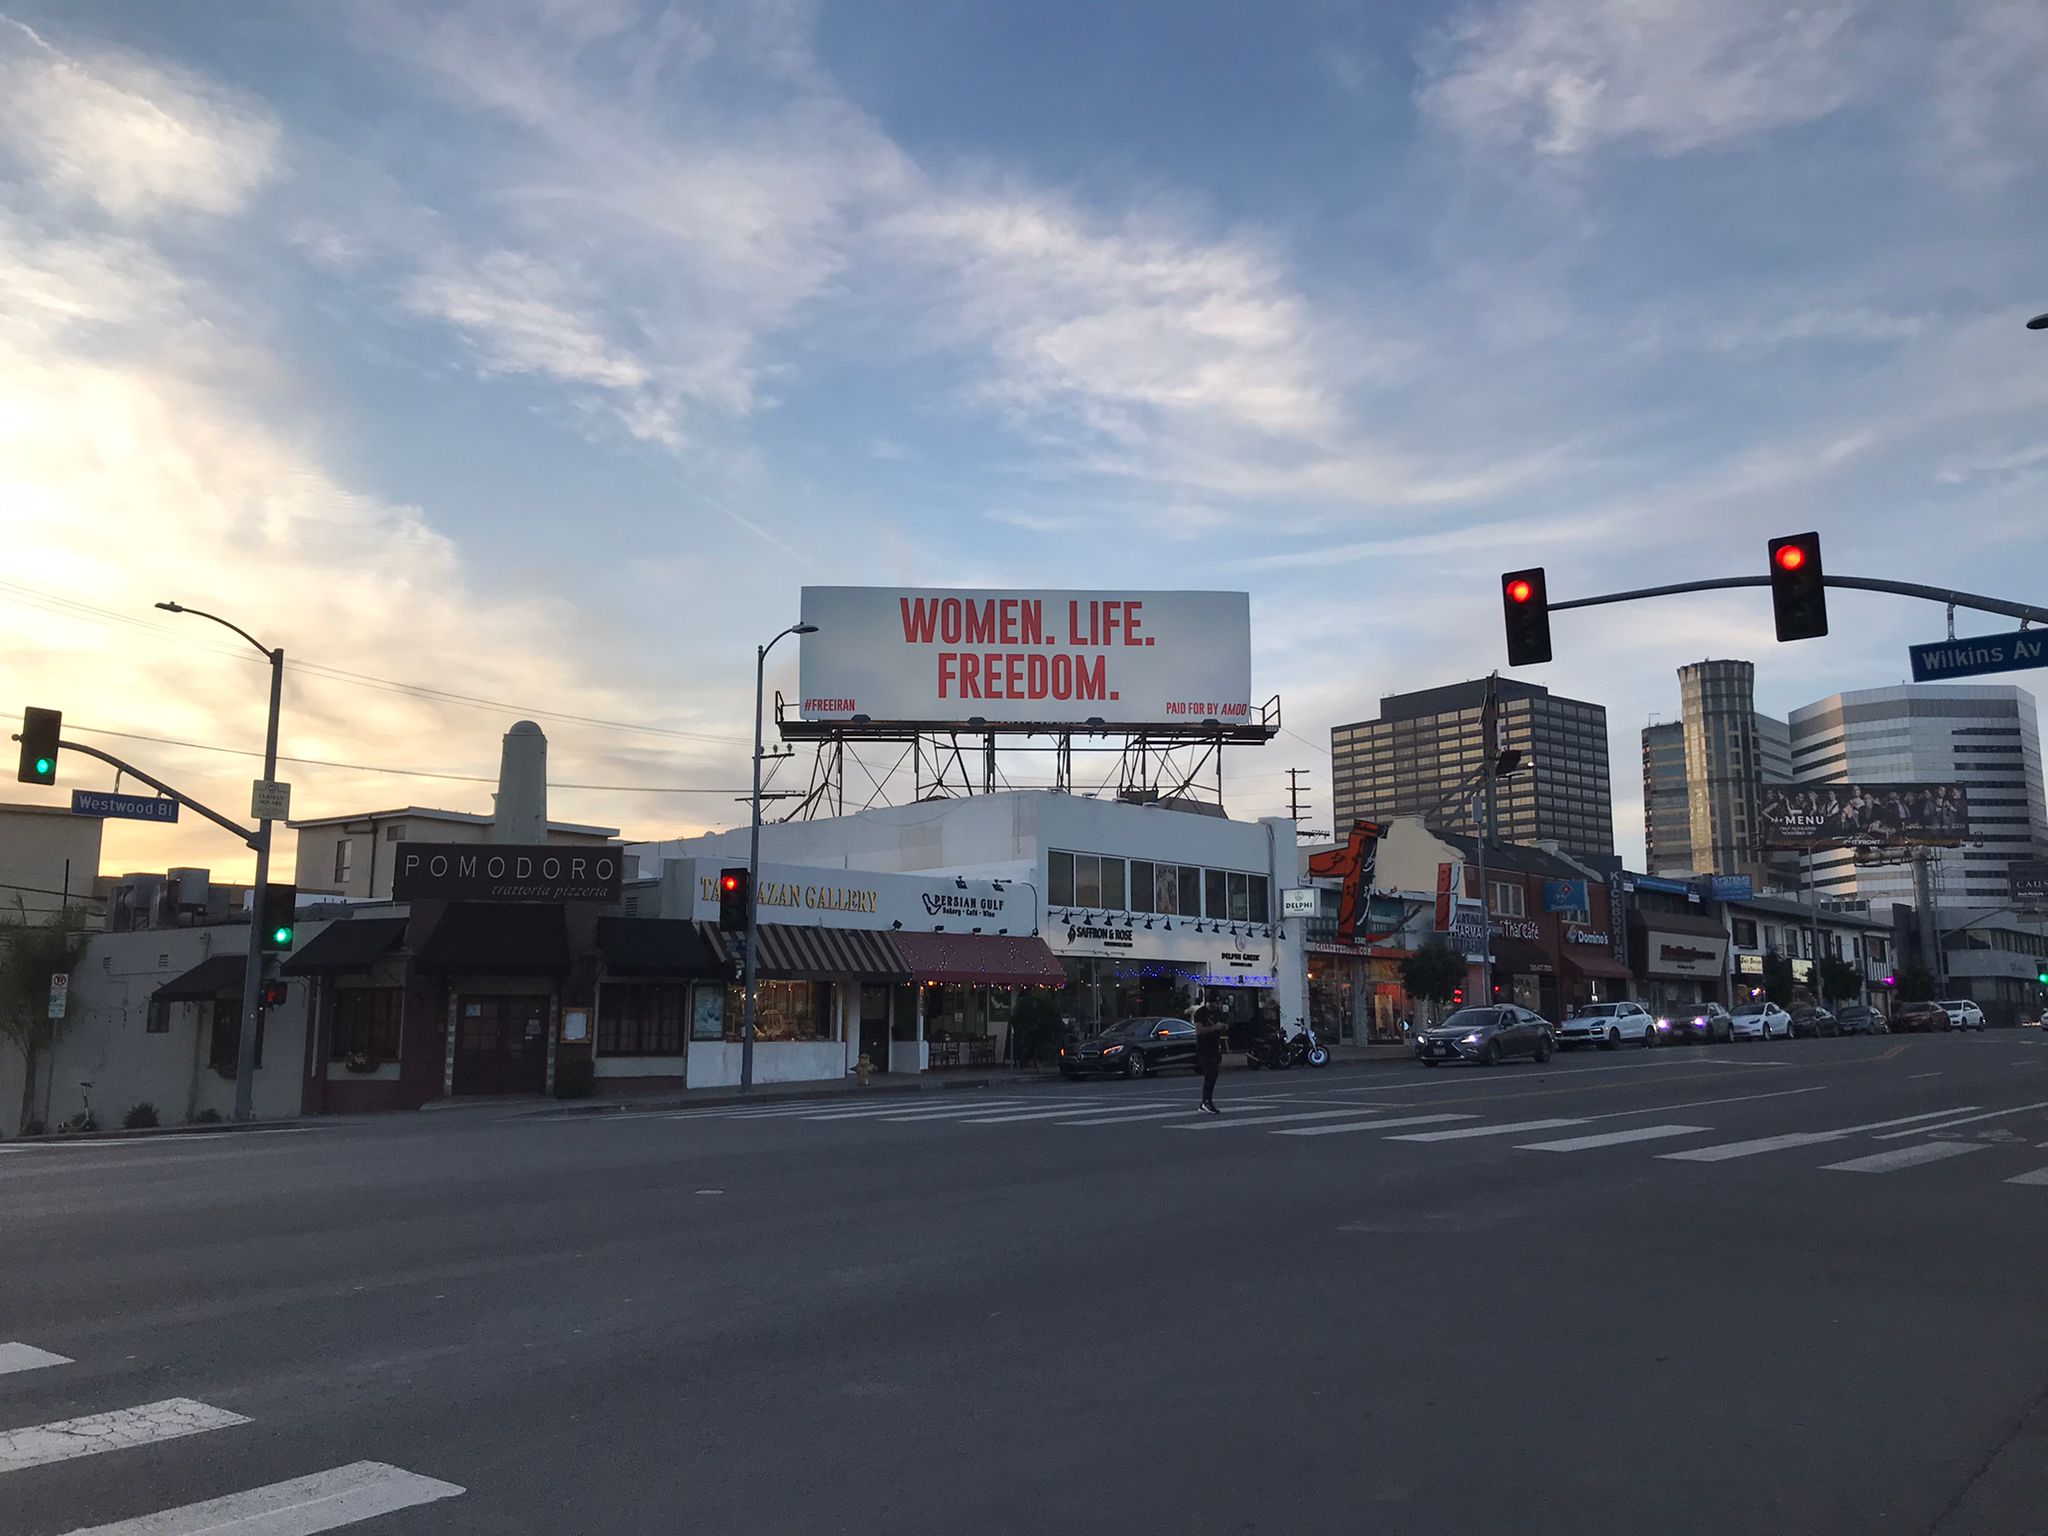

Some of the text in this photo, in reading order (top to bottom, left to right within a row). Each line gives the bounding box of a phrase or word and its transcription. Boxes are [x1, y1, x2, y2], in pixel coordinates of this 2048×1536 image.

[899, 597, 1155, 646] WOMEN. LIFE.
[1921, 640, 2042, 671] Wilkins Av
[937, 653, 1120, 700] FREEDOM.
[804, 698, 855, 711] #FREEIRAN
[1166, 702, 1248, 716] PAID FOR BY AMOO
[79, 795, 172, 816] Westwood Bl
[1785, 815, 1825, 825] MENU
[404, 855, 614, 881] POMODORO
[491, 884, 609, 899] trattoria pizzeria
[805, 884, 877, 913] GALLERY
[934, 894, 1004, 911] PERSIAN GULF
[1610, 871, 1624, 963] KICKBOXING
[1076, 926, 1133, 941] SAFFRON & ROSE
[1500, 919, 1521, 938] Thai
[1578, 930, 1608, 945] Domino's
